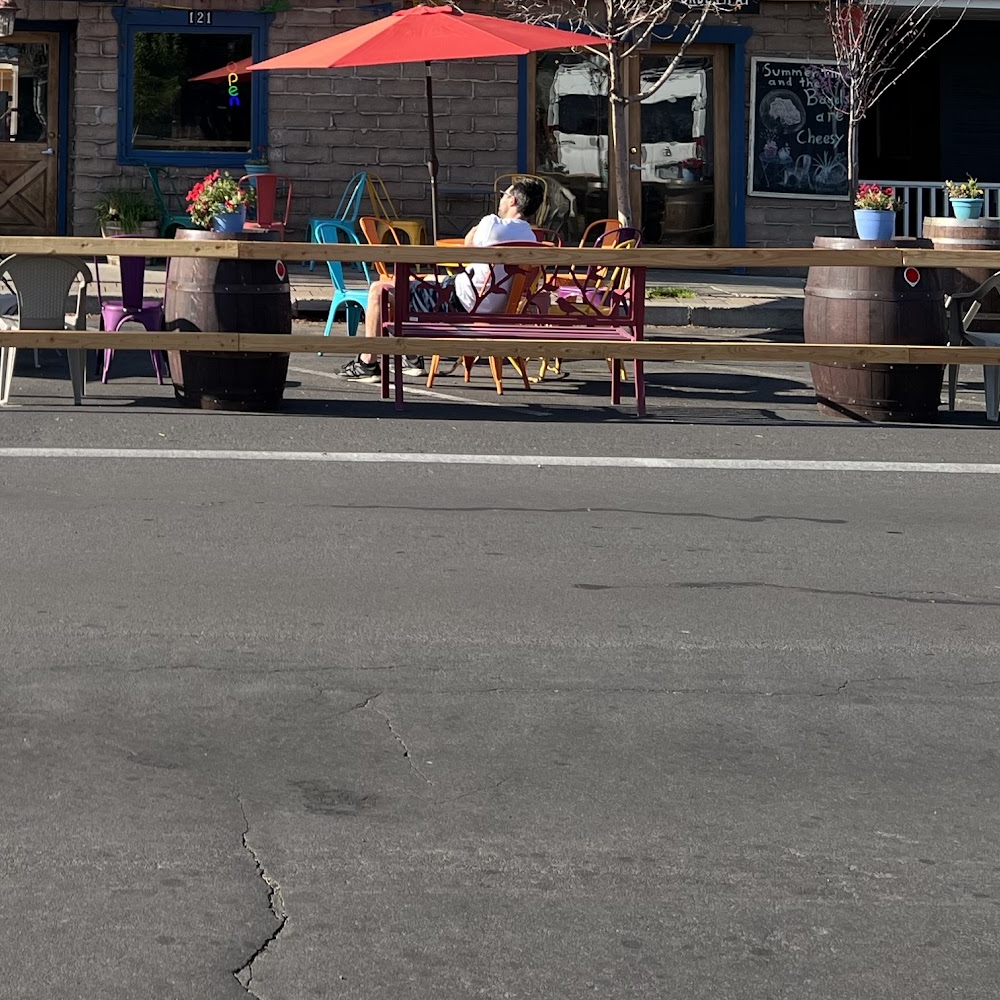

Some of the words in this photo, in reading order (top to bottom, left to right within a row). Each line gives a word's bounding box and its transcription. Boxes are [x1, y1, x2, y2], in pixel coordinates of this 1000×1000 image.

[189, 11, 212, 24] 121
[768, 77, 793, 87] and
[799, 77, 821, 88] the
[816, 112, 844, 123] are
[796, 127, 845, 149] Cheesy
